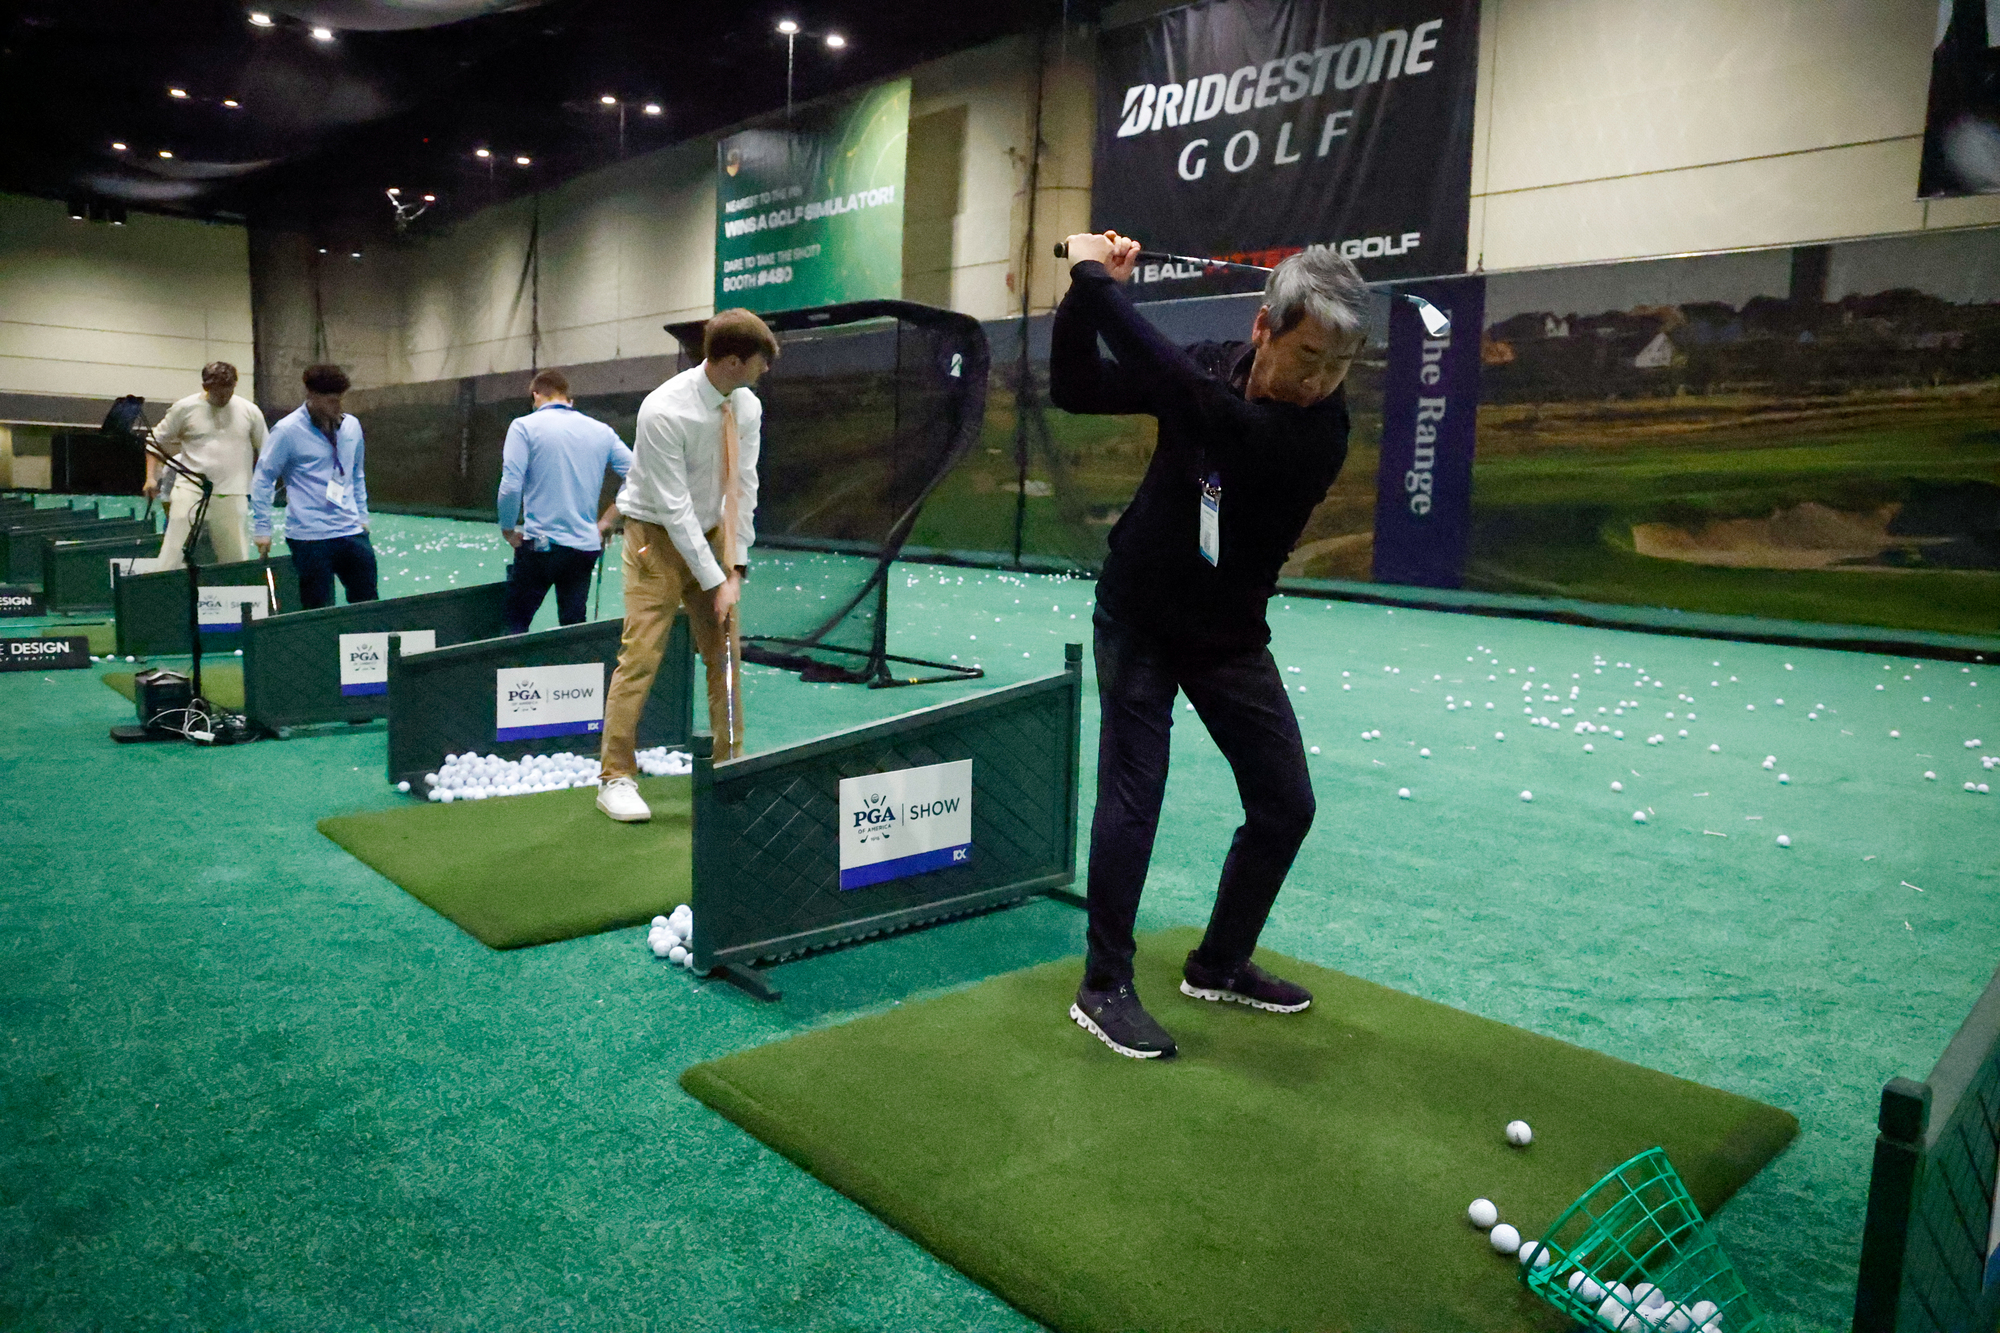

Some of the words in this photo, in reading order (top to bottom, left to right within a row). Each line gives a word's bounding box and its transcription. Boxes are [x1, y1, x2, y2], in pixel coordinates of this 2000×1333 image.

[1117, 19, 1443, 138] BRIDGESTONE
[1178, 110, 1353, 181] GOLF
[757, 214, 768, 231] A
[768, 206, 803, 230] GOLF
[1144, 263, 1203, 284] BALL
[1341, 232, 1420, 260] GOLF
[1404, 396, 1446, 515] Range
[11, 641, 70, 655] DESIGN
[350, 652, 379, 662] PGA
[508, 690, 541, 701] PGA
[553, 688, 594, 700] SHOW
[853, 806, 896, 828] PGA
[910, 797, 960, 820] SHOW
[868, 824, 892, 833] AMERICA
